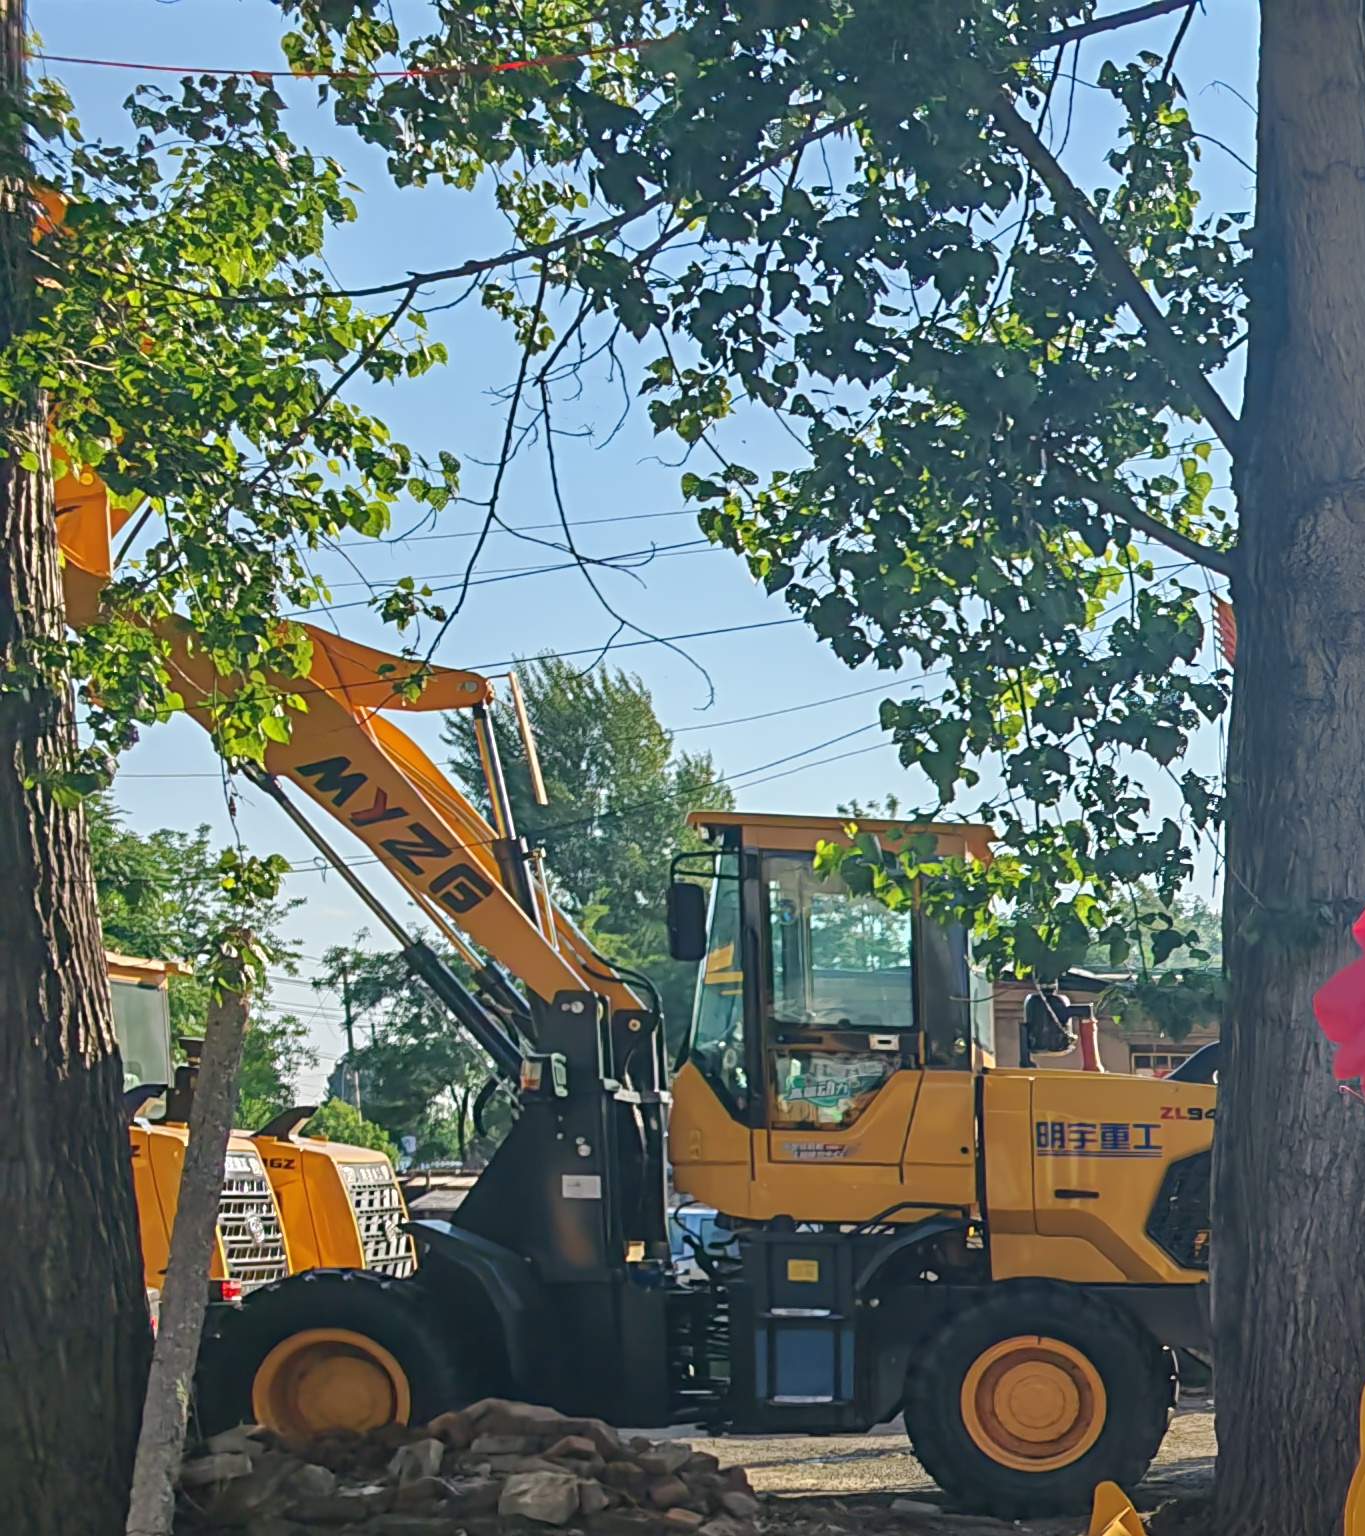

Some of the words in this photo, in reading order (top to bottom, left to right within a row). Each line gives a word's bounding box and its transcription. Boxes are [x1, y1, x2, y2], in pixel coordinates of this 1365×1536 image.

[295, 756, 493, 914] MYZG
[1036, 1121, 1163, 1150] 明宇重工
